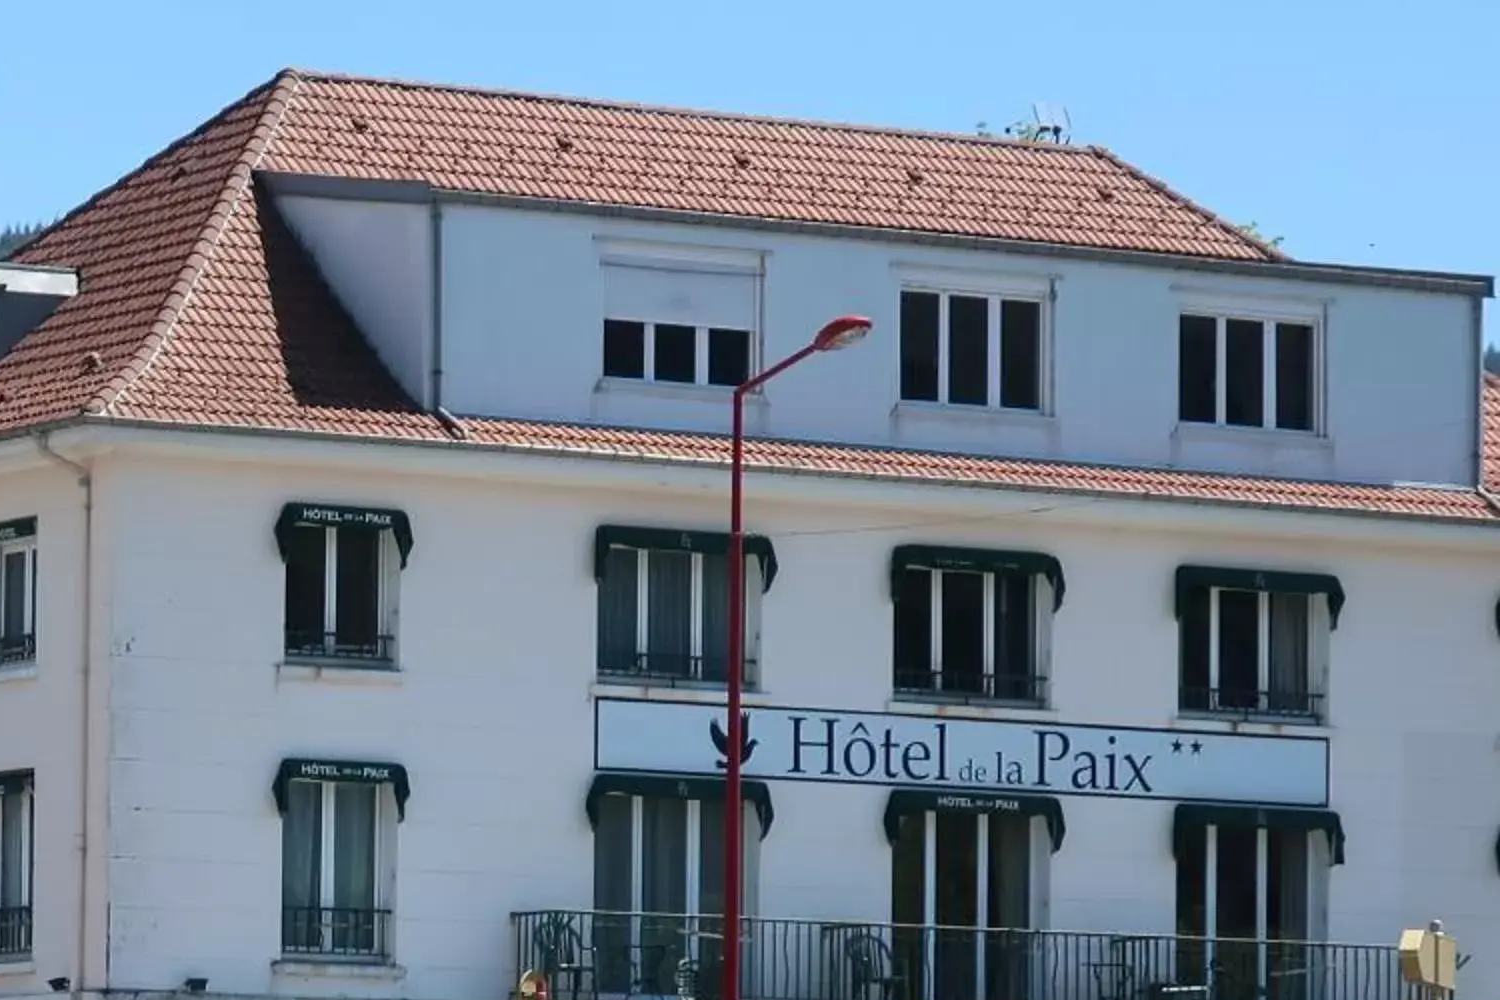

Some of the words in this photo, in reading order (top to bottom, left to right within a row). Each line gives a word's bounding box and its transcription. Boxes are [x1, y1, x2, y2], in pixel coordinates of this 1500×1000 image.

[788, 716, 950, 781] Hôtel
[959, 758, 988, 783] de
[996, 751, 1024, 785] la
[1033, 730, 1154, 793] Paix
